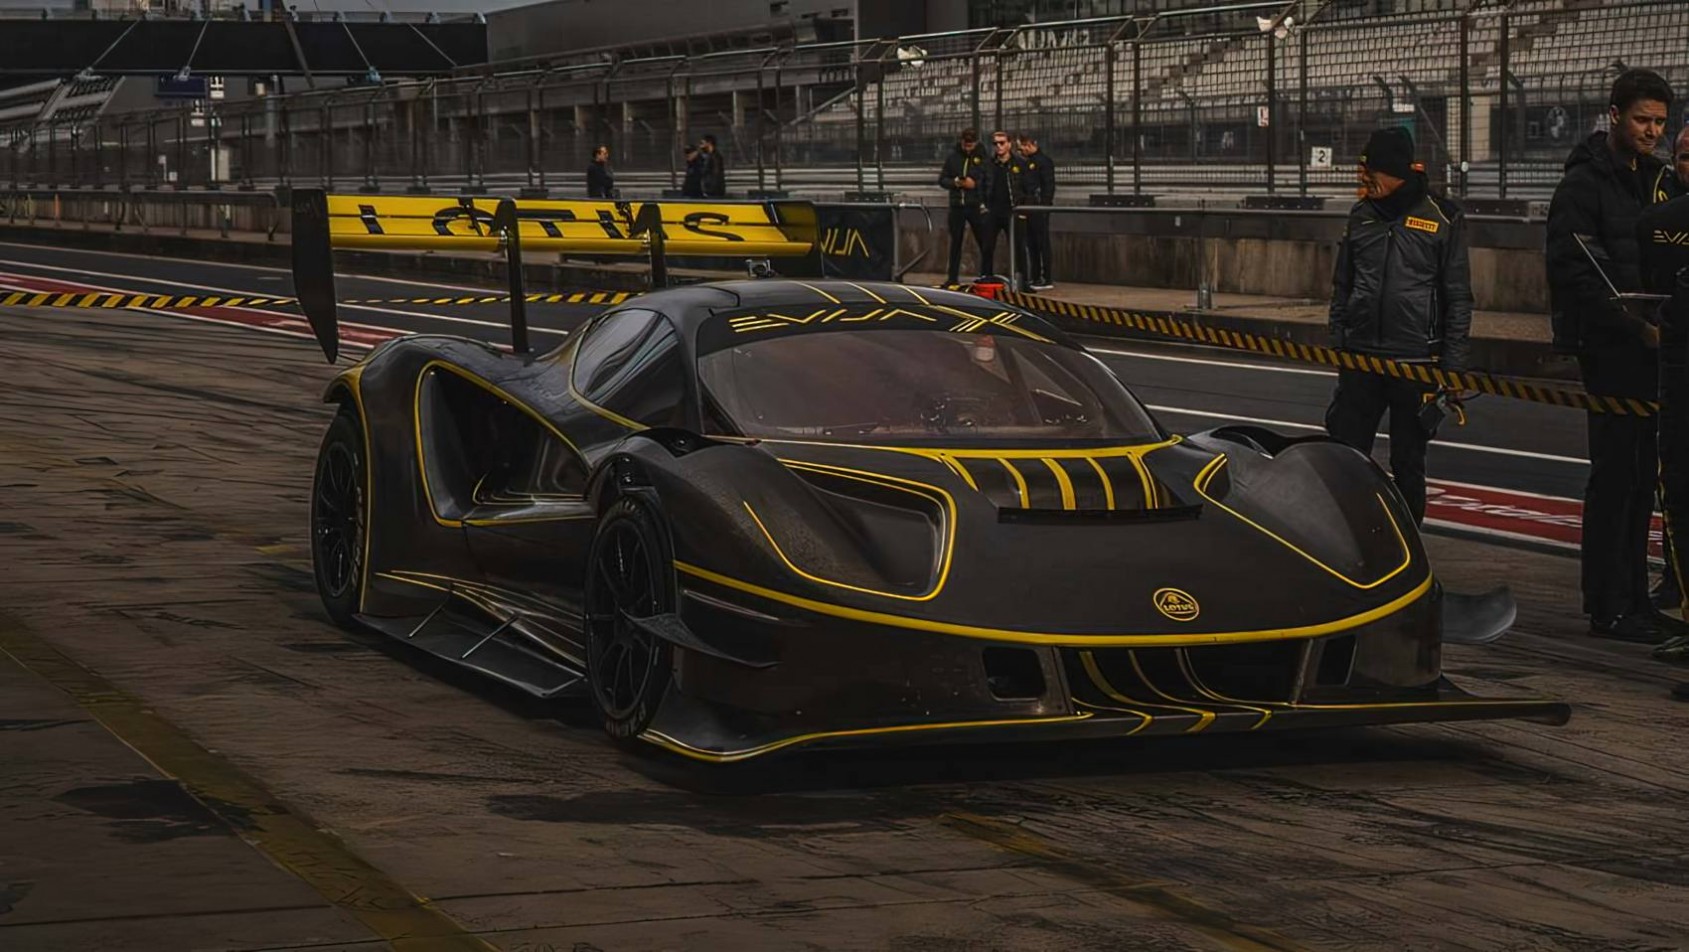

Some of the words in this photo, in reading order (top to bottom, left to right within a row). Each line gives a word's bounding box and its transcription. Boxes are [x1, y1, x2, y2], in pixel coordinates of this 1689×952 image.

[1317, 150, 1326, 163] 2
[821, 228, 869, 257] VIJA
[729, 307, 937, 332] EVIJA
